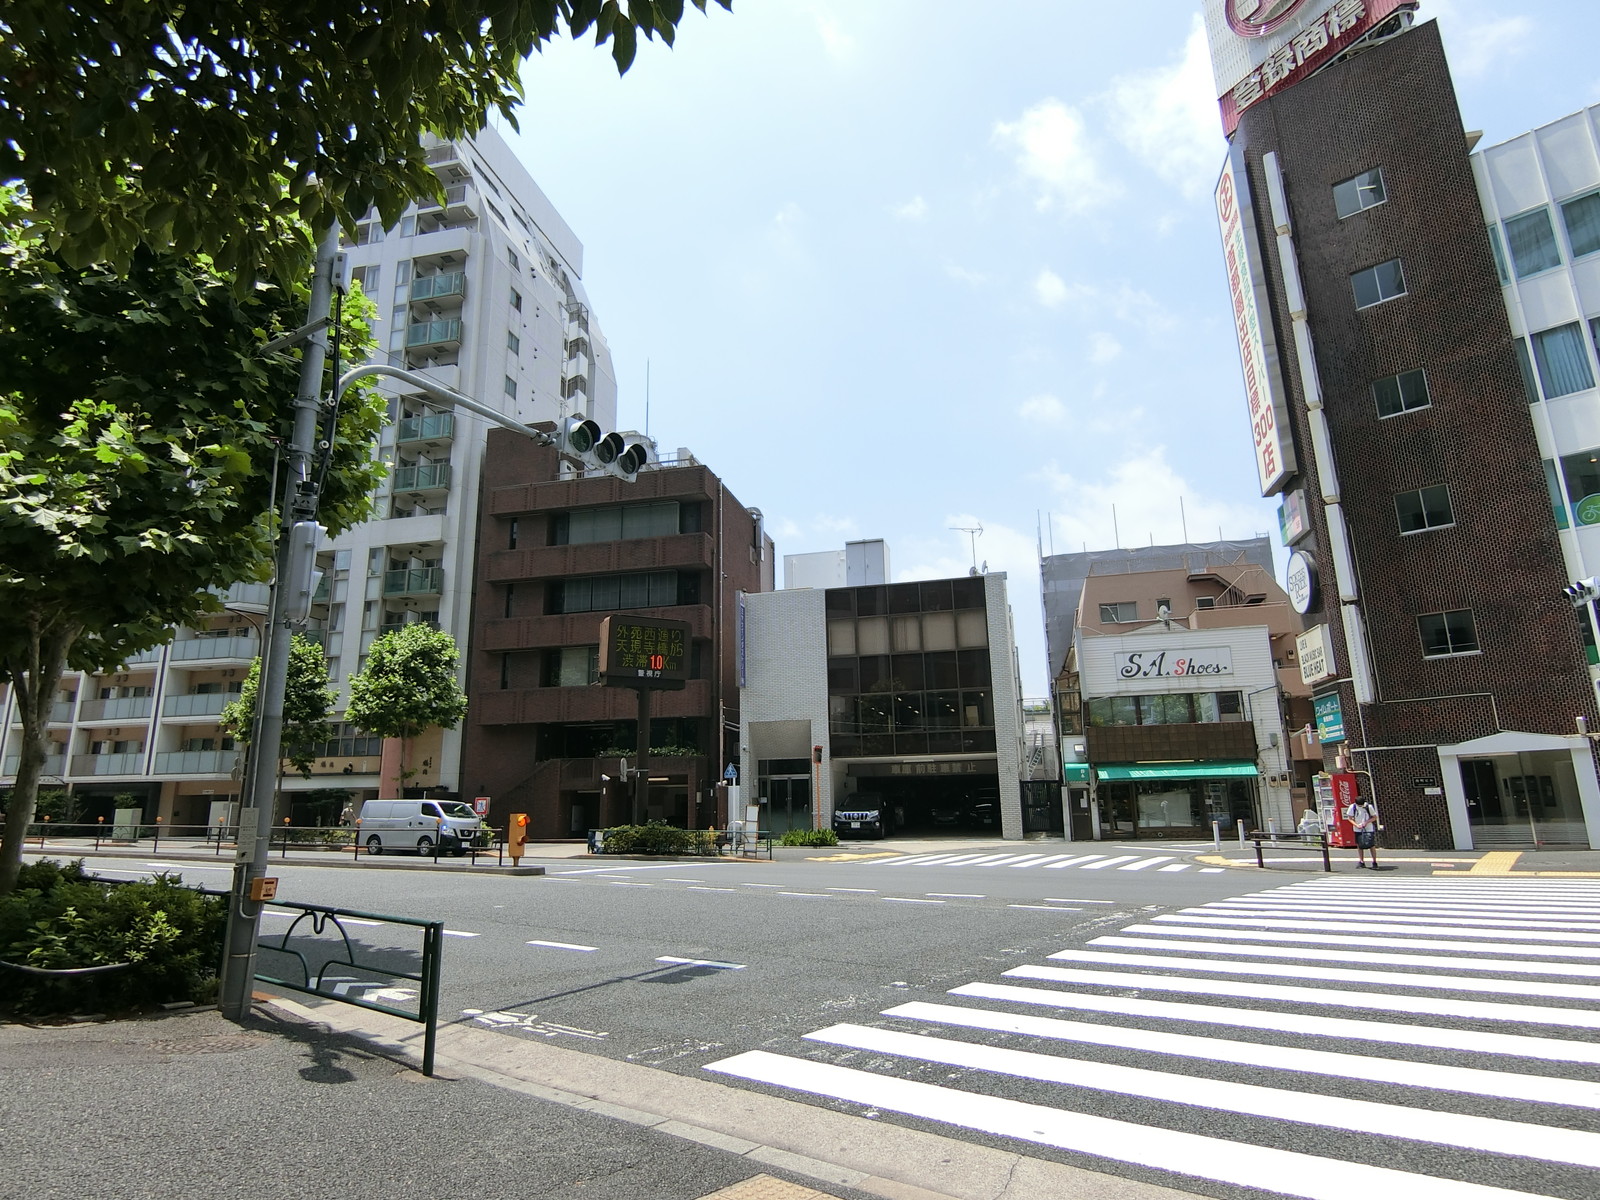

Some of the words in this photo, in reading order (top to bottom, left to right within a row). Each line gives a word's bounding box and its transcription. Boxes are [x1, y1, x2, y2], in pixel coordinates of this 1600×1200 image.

[1232, 0, 1366, 114] 登録商標
[616, 624, 682, 642] 外苑西通り
[616, 638, 684, 657] 天現寺橋から
[637, 669, 662, 678] 警視庁
[1302, 664, 1314, 679] BLUE
